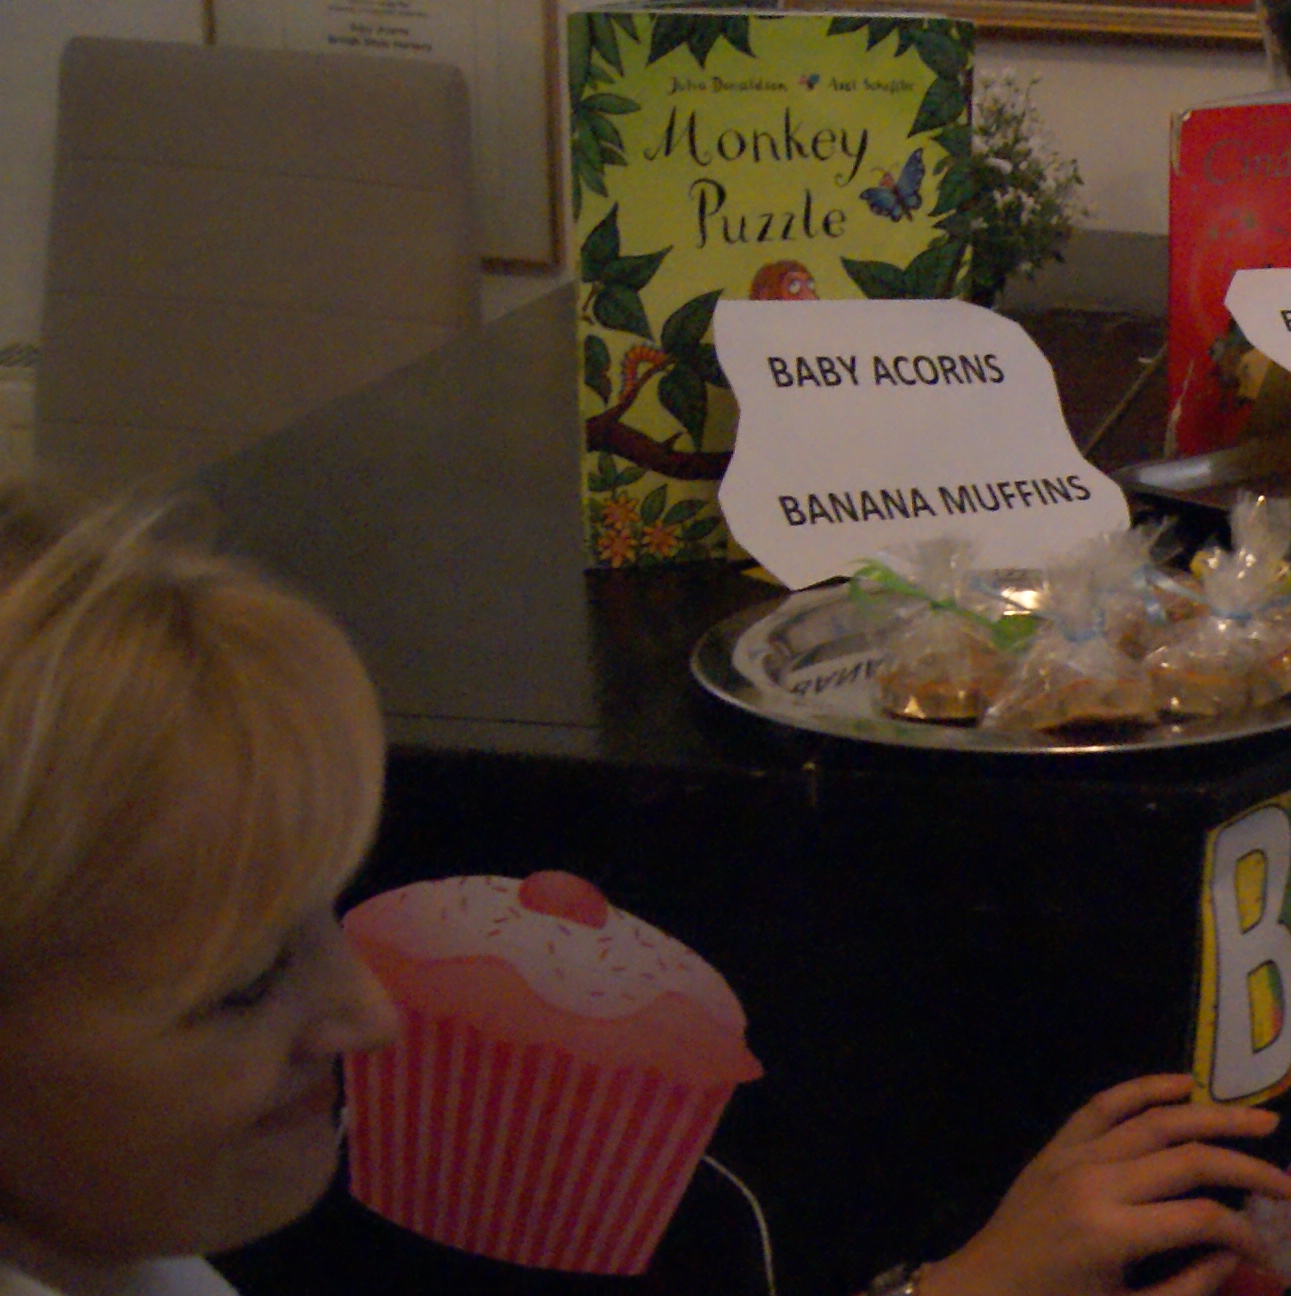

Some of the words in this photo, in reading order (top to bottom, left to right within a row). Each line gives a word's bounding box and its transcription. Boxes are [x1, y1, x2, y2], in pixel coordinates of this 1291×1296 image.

[644, 105, 869, 188] Monkey
[690, 178, 848, 249] Puzzle
[768, 355, 861, 389] BABY
[873, 353, 1006, 386] ACORNS
[779, 487, 937, 527] BANANA
[940, 474, 1091, 515] MUFFINS
